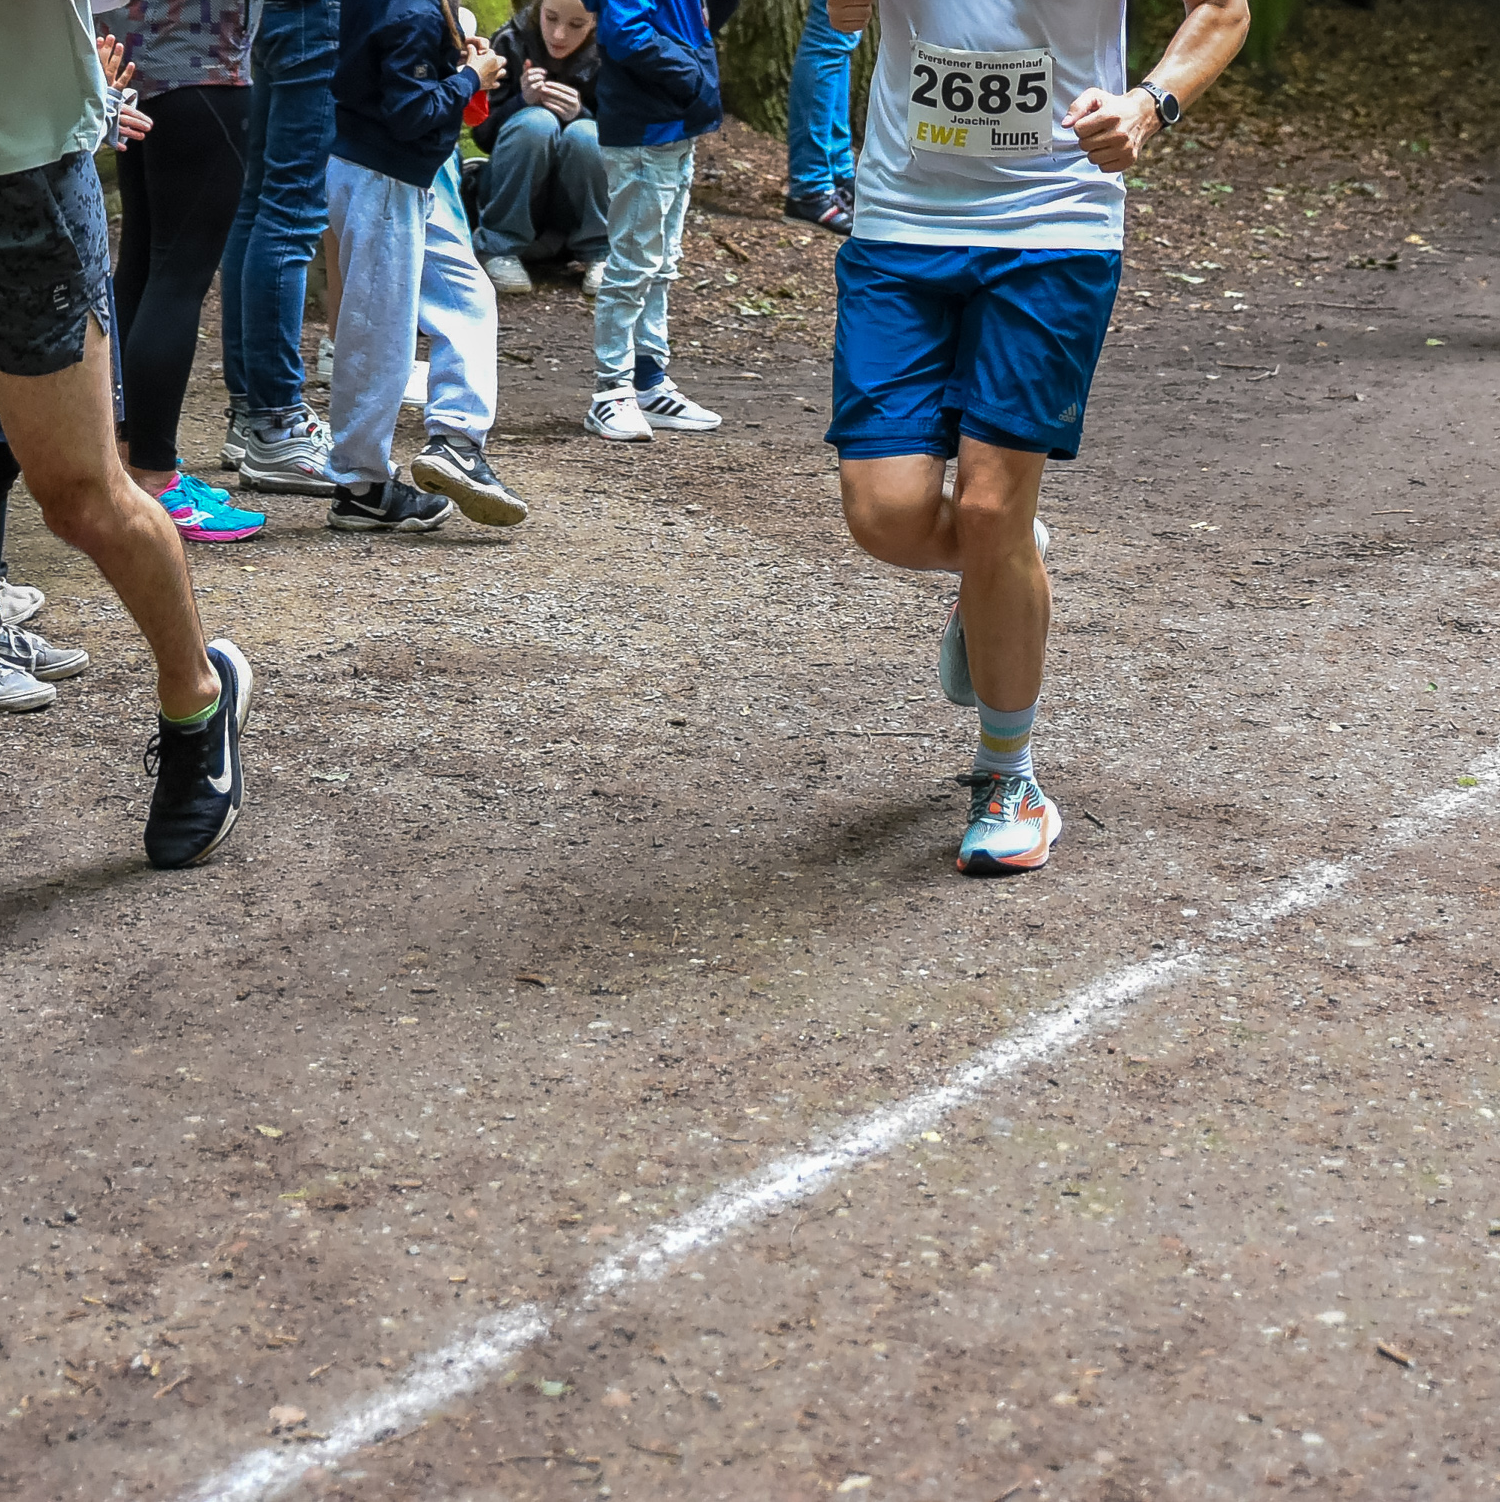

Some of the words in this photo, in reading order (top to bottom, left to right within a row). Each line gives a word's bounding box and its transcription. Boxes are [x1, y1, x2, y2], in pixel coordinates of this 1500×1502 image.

[917, 49, 972, 70] Everstener
[974, 58, 1043, 71] Brunnenlauf
[911, 63, 1049, 115] 2685
[950, 114, 1001, 127] Joachim
[916, 121, 969, 148] EWE
[991, 127, 1039, 146] bruns
